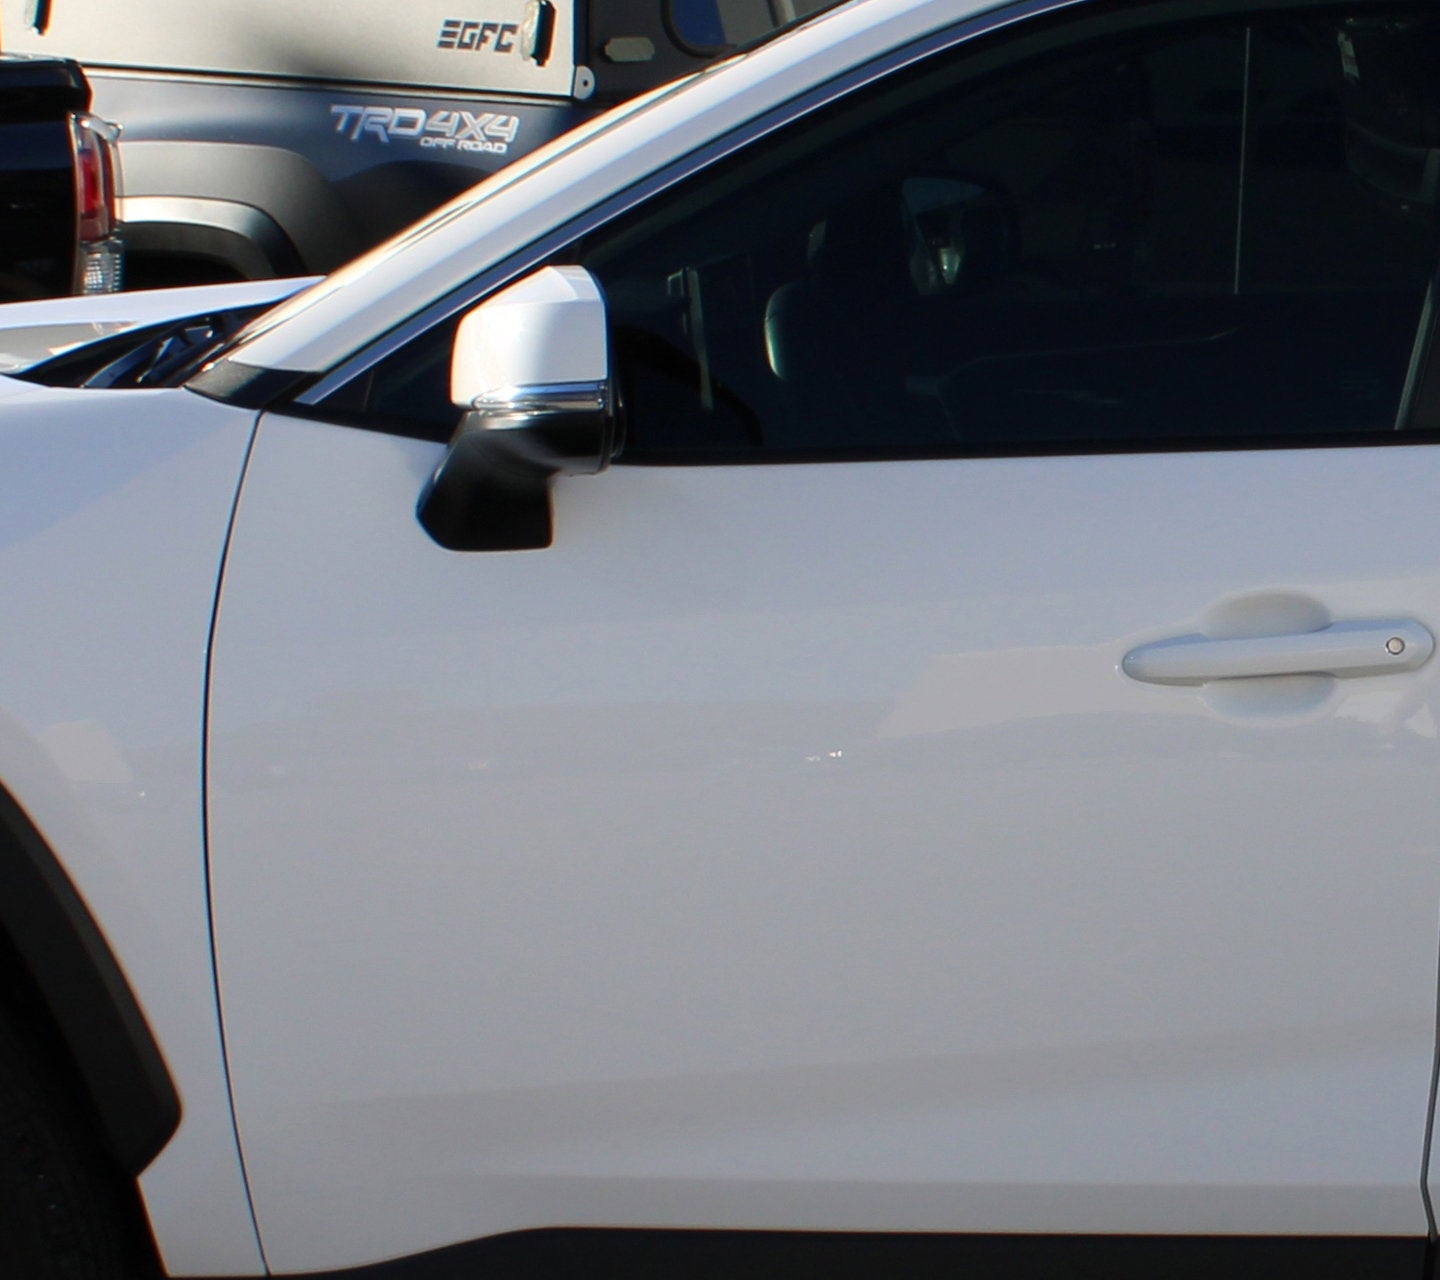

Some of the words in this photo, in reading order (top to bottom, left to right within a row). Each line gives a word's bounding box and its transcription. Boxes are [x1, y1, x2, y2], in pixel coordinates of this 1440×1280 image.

[329, 103, 426, 143] TRD
[419, 136, 456, 151] OFF
[456, 138, 508, 154] ROAD
